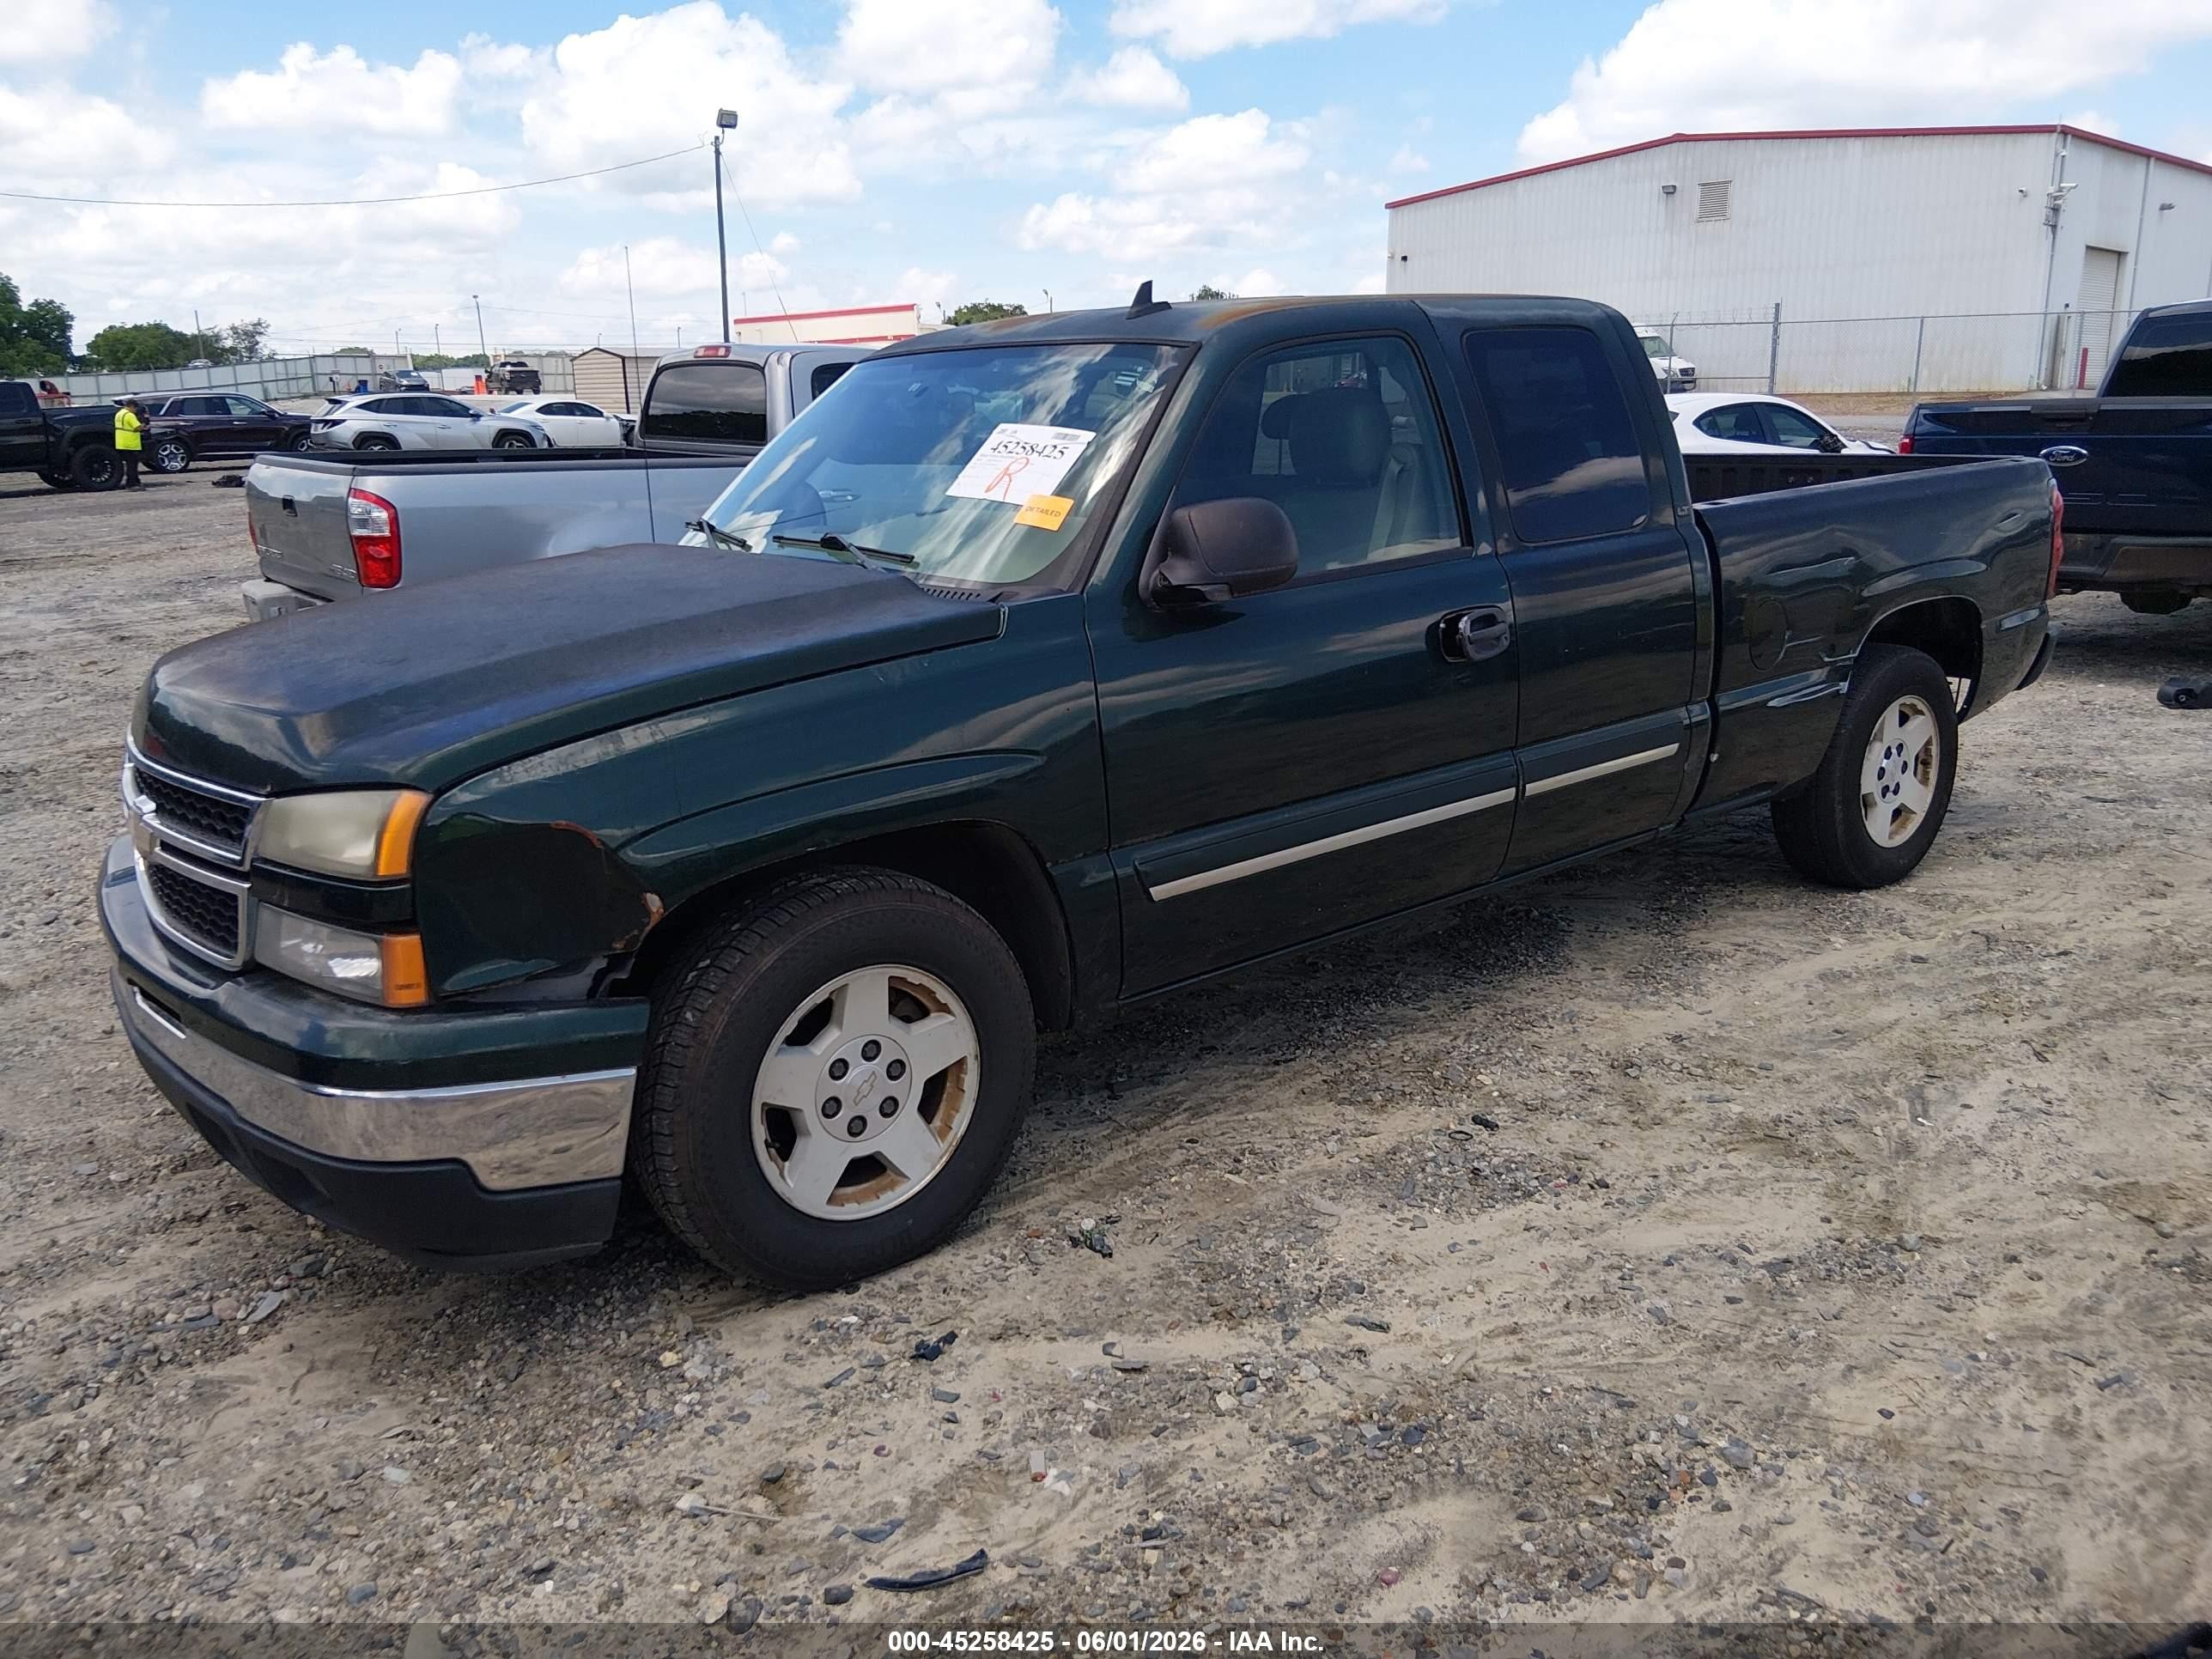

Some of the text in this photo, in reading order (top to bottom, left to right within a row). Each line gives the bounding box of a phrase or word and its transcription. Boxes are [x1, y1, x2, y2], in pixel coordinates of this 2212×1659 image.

[990, 440, 1070, 460] 45258425
[984, 456, 1030, 501] R
[1024, 506, 1062, 518] DETAILED
